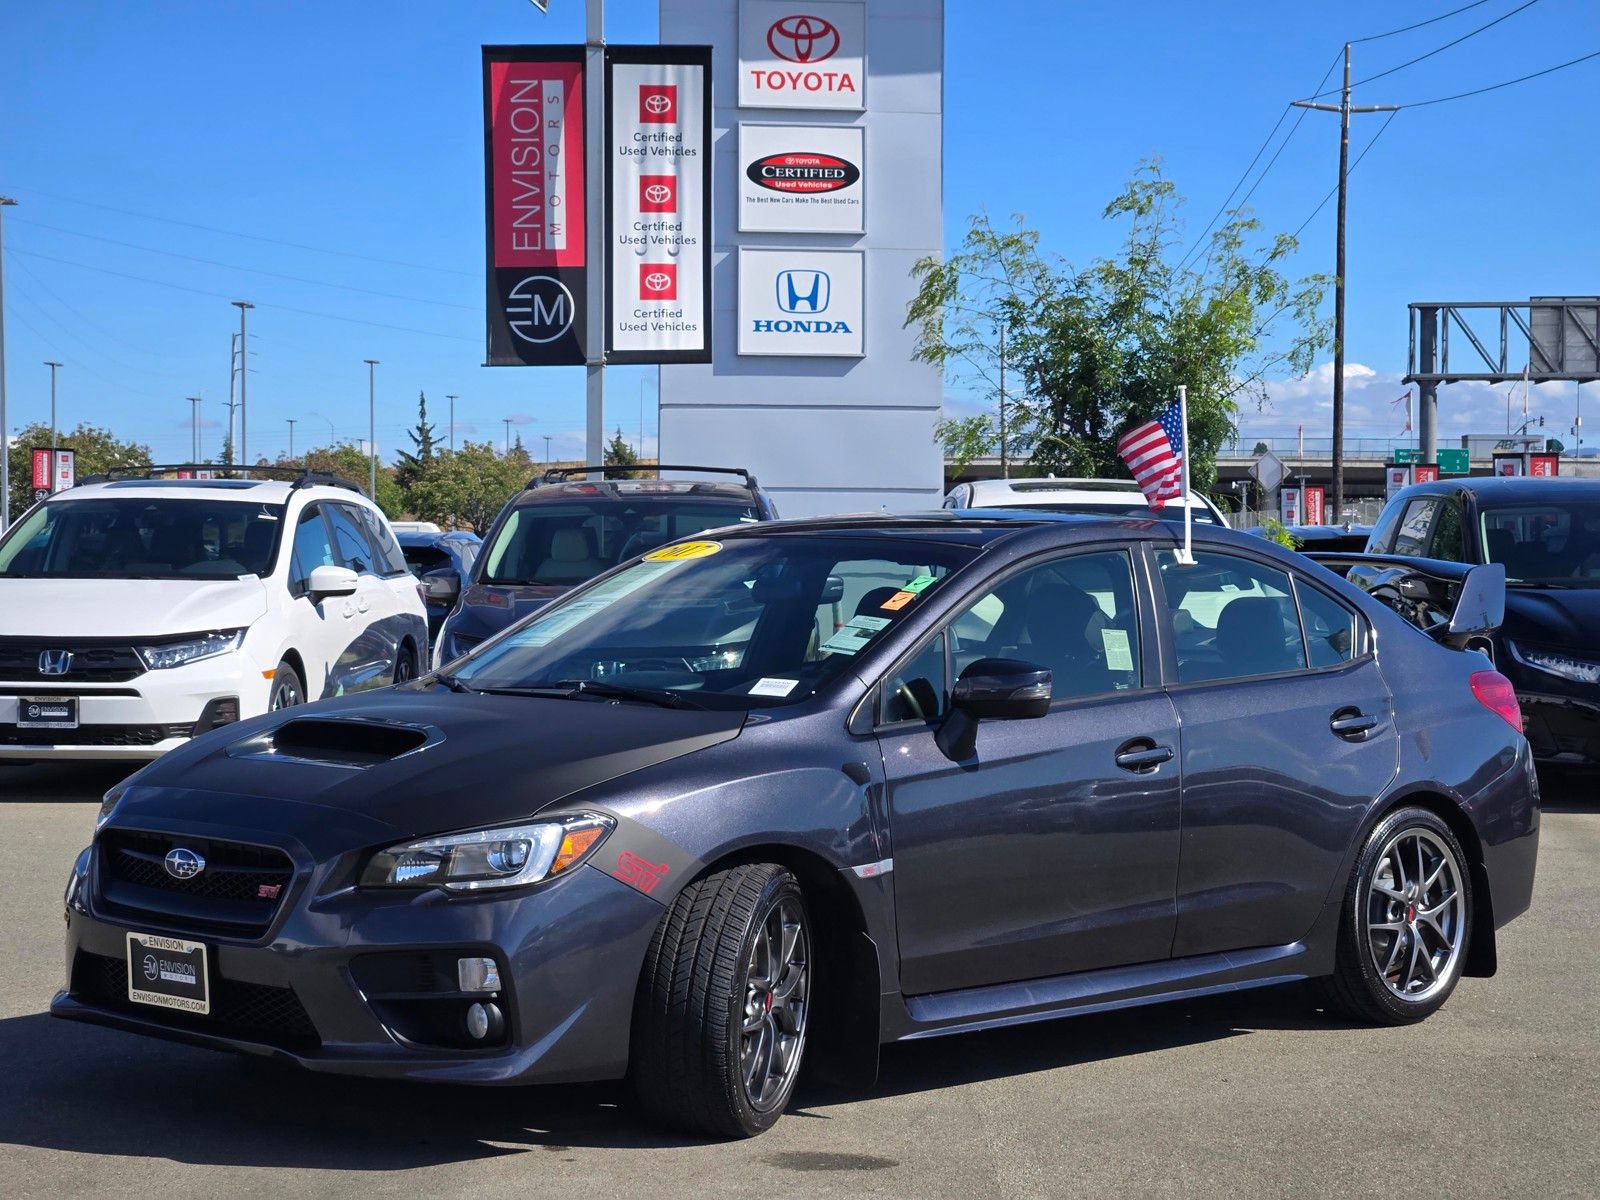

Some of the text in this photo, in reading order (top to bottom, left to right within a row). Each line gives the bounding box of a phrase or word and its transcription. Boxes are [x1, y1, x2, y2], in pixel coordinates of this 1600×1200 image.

[751, 71, 855, 91] TOYOTA
[633, 132, 682, 142] Certified
[619, 146, 697, 156] Used Vehicles
[510, 80, 541, 250] ENVISION
[547, 95, 561, 235] MOTORS
[761, 166, 845, 178] CERTIFIED
[633, 221, 682, 231] Certified
[619, 235, 697, 245] Used Vehicles
[633, 309, 683, 318] Certified
[619, 322, 697, 331] Used Vehicles
[752, 320, 853, 333] HONDA
[148, 936, 184, 951] ENVISION
[160, 960, 196, 976] ENVISION
[132, 991, 206, 1011] ENVISIONMOTORS.COM
